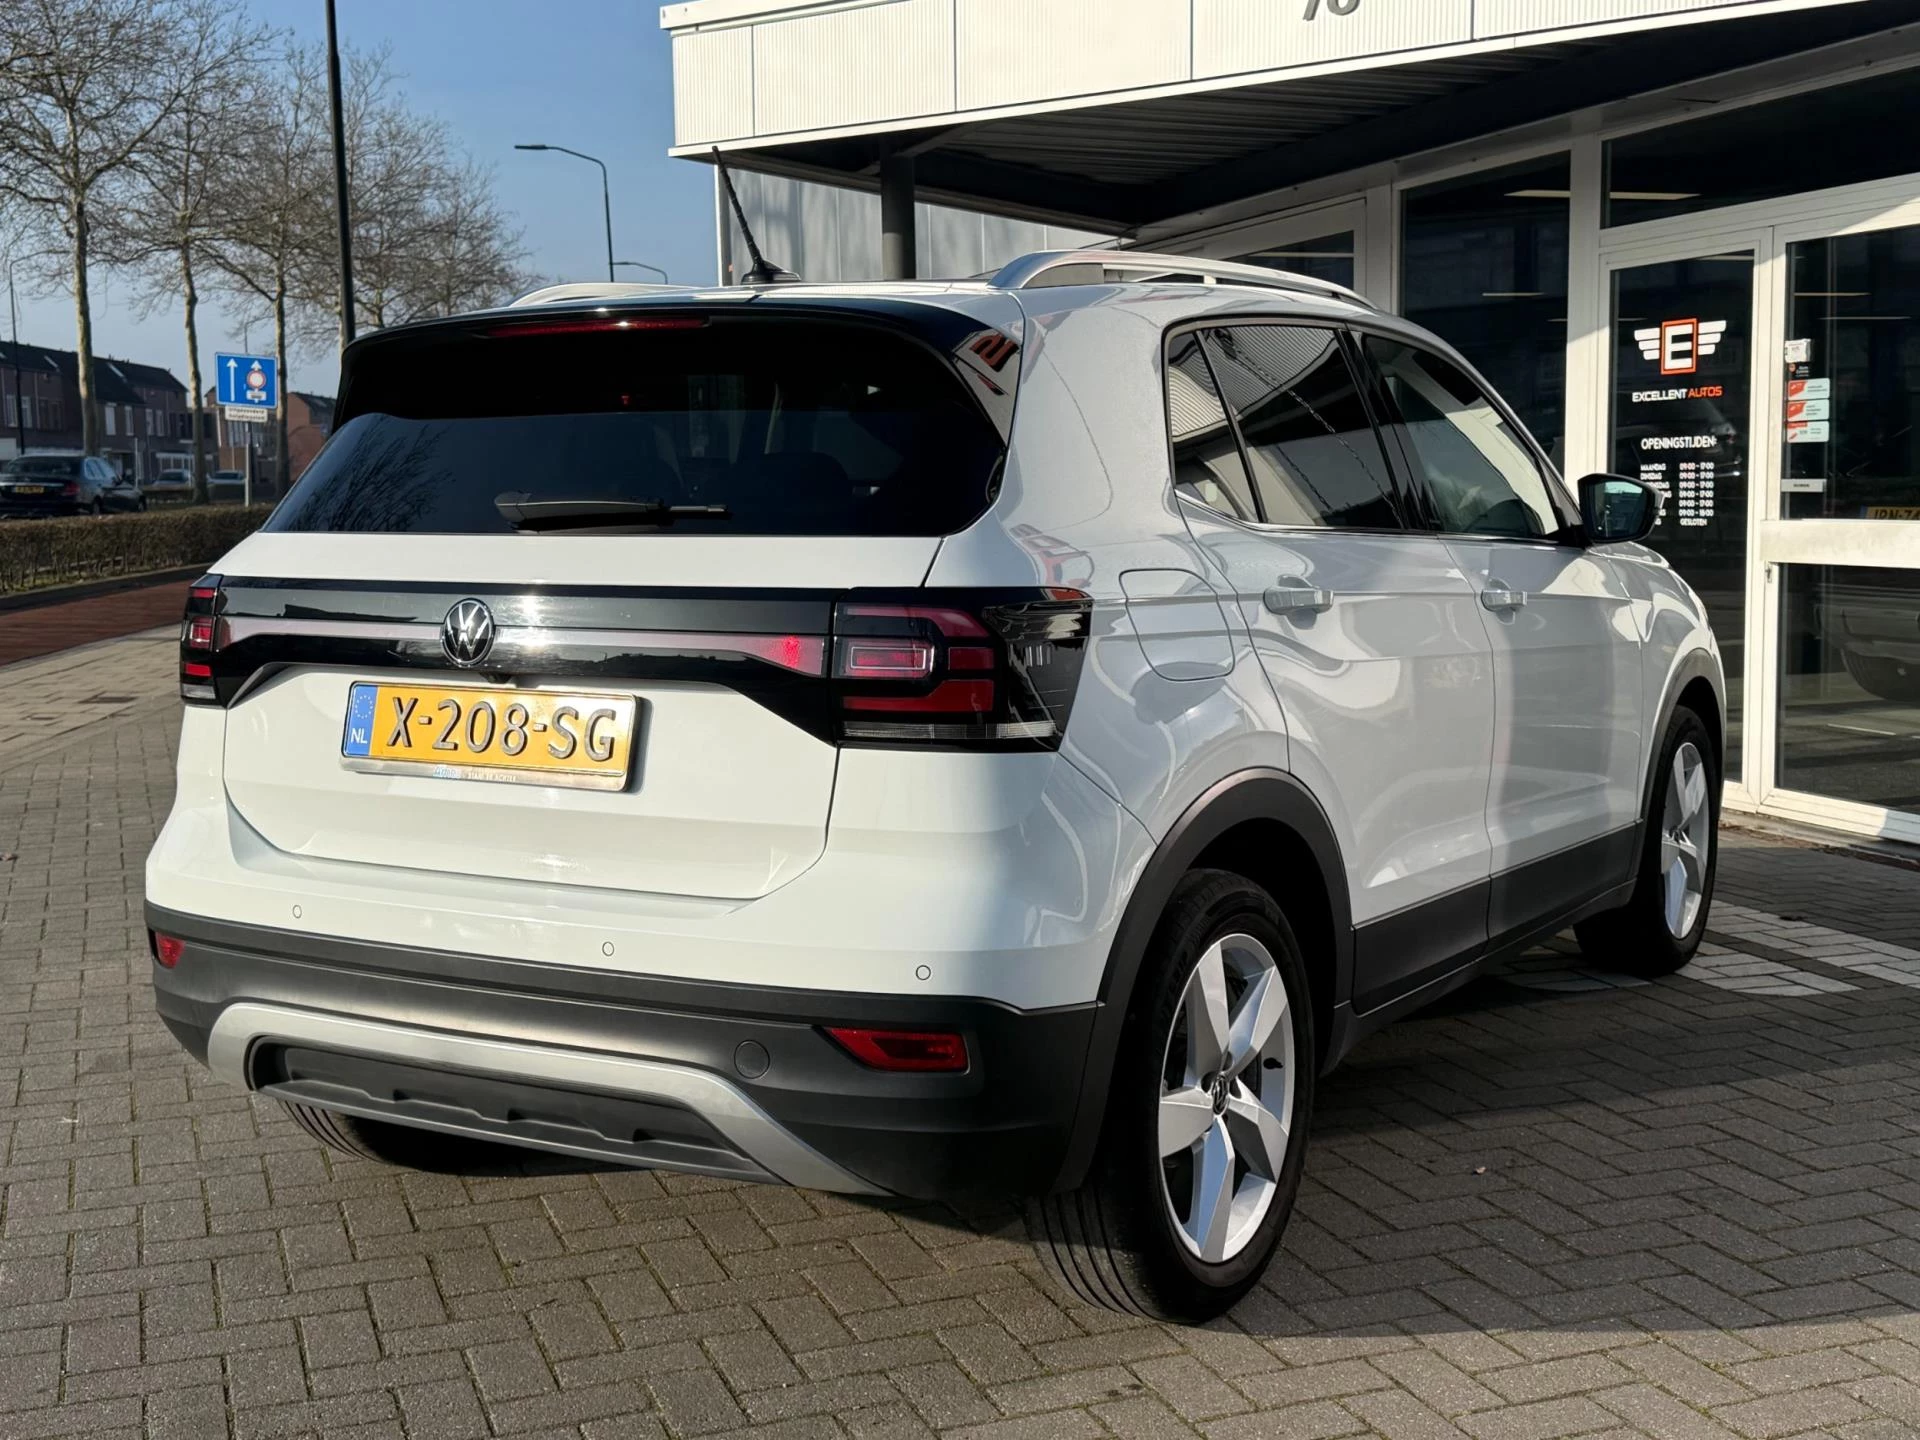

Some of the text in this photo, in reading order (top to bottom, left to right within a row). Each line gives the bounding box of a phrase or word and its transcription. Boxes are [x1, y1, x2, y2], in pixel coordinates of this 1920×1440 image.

[1664, 323, 1693, 370] E
[1632, 385, 1723, 402] EXCELLENT AUTOS
[1641, 434, 1718, 450] OPENINGSTIJDEN:
[350, 728, 369, 745] NL
[386, 696, 617, 763] X-208-SG
